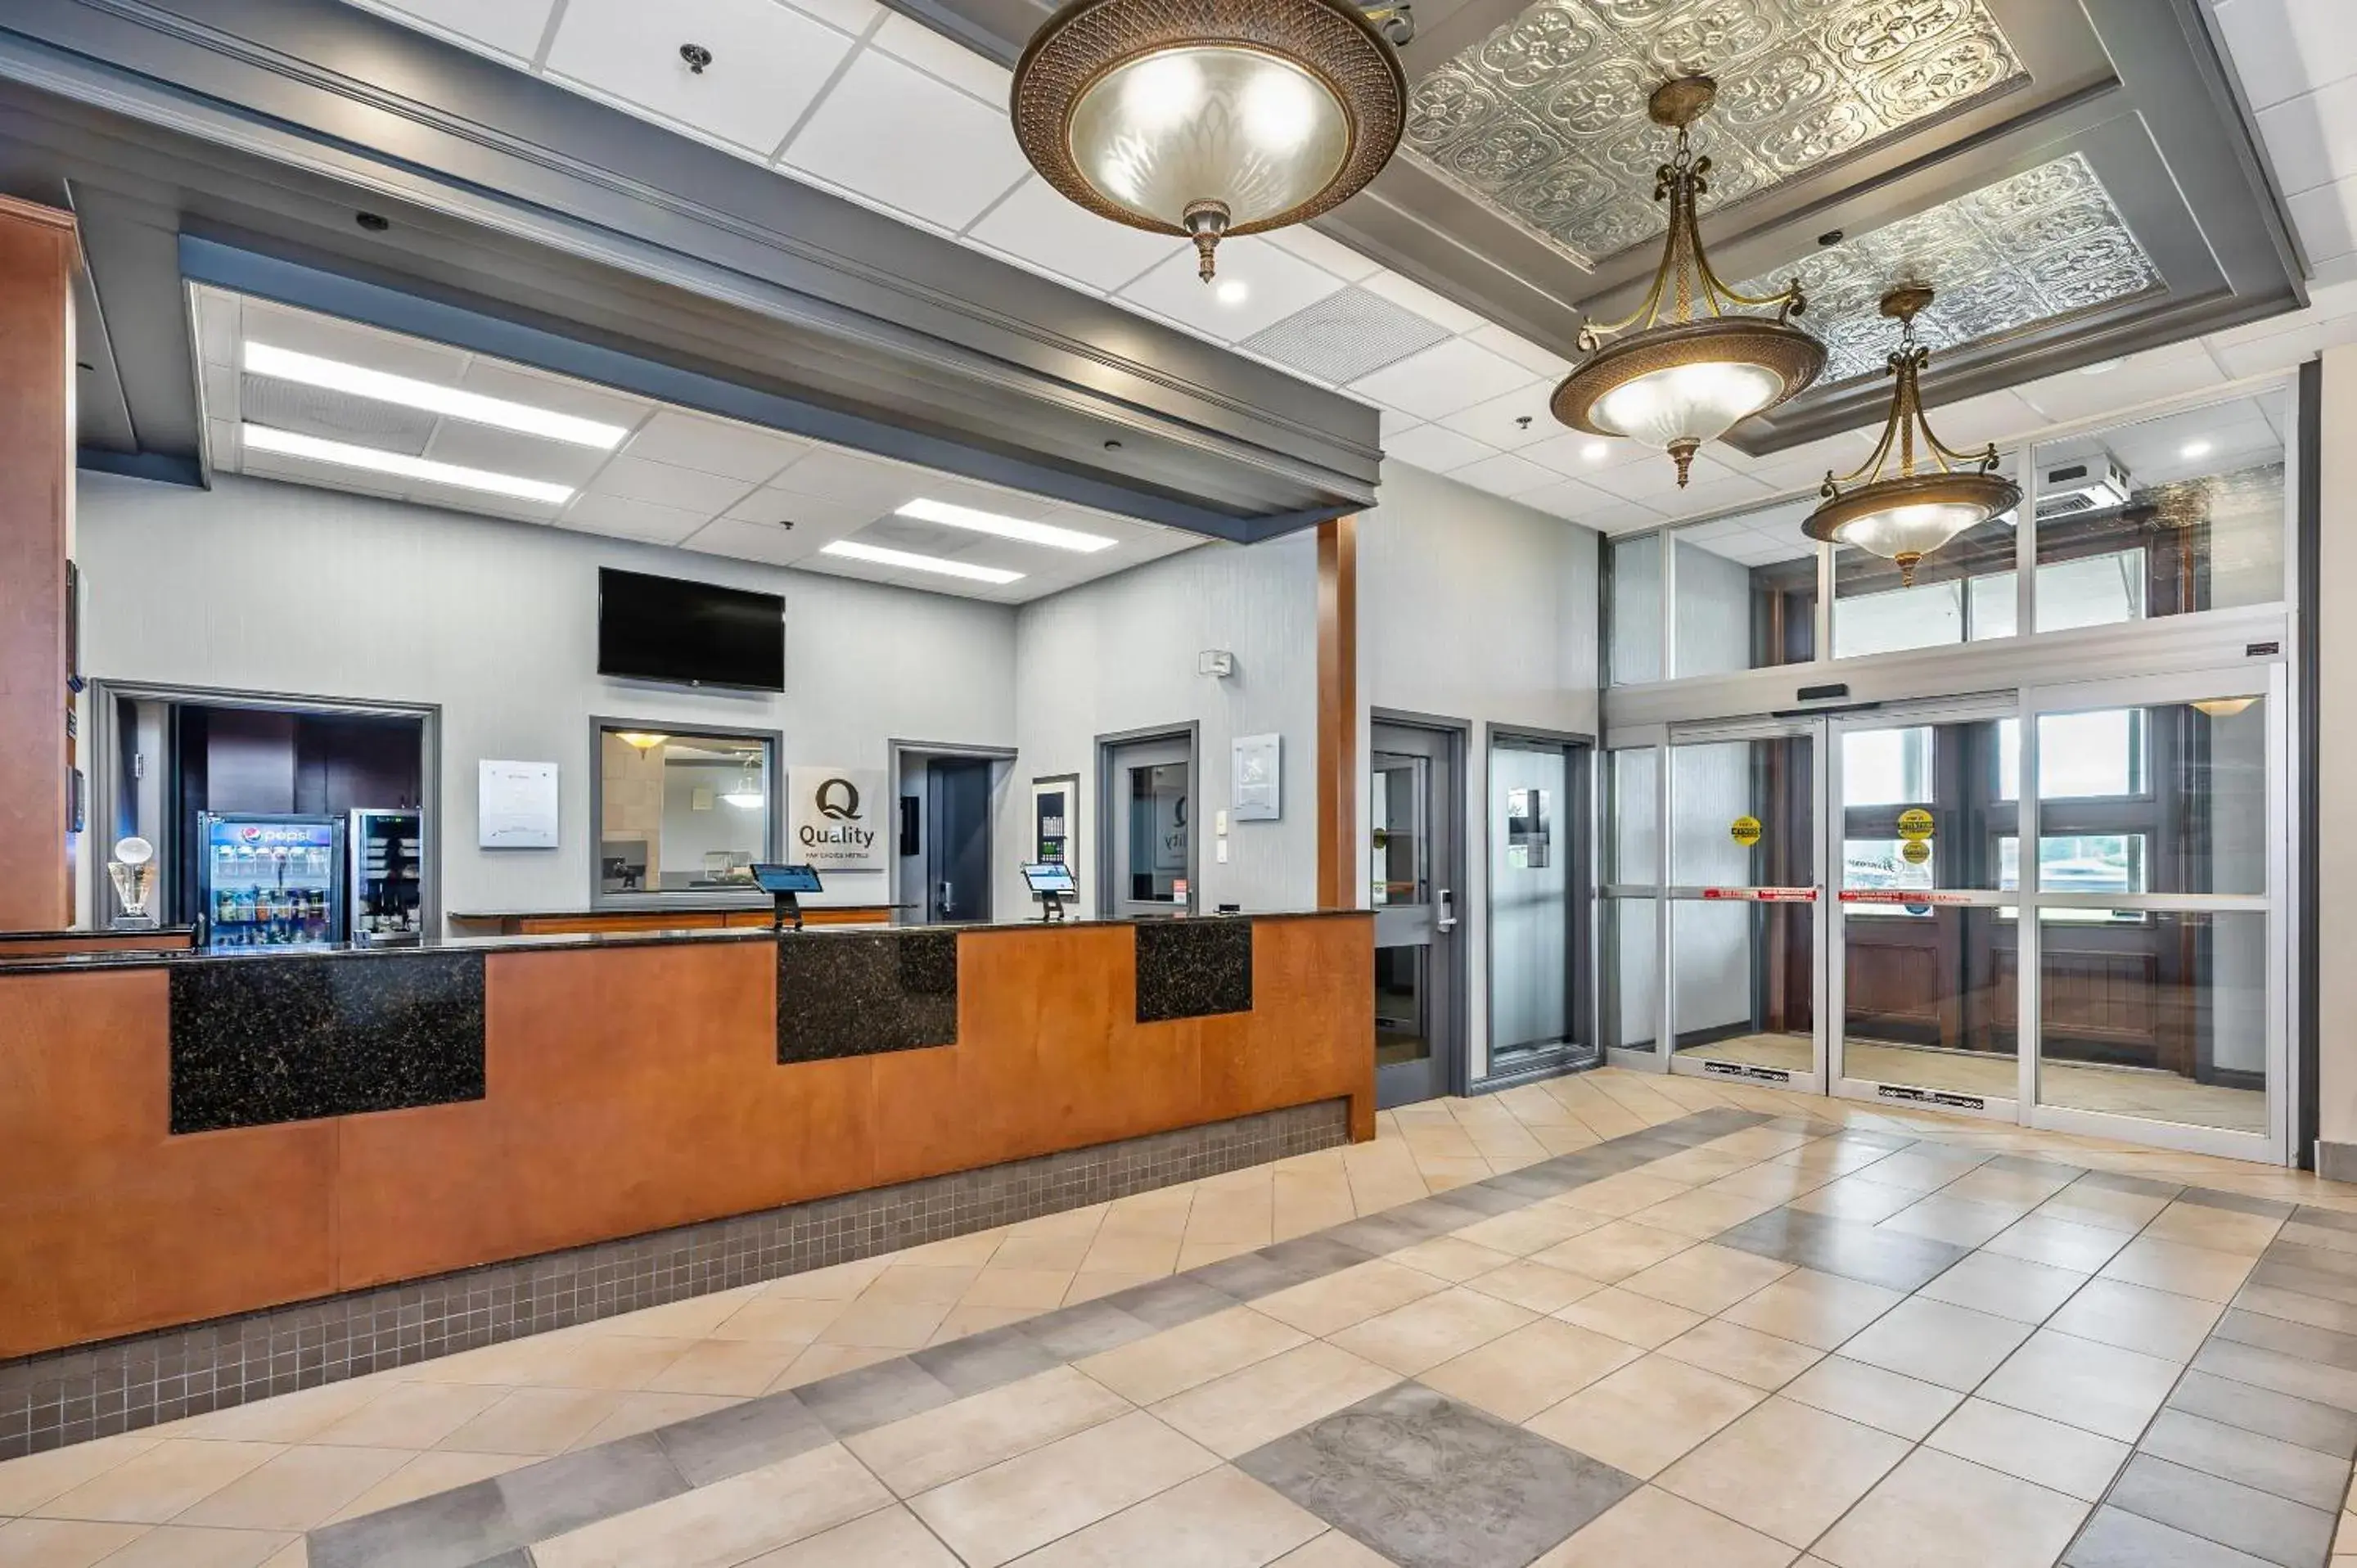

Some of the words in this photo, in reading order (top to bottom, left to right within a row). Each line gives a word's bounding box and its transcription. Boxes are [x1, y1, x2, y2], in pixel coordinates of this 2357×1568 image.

[815, 778, 863, 820] Q
[264, 830, 310, 842] pepsi
[800, 825, 874, 849] Quality
